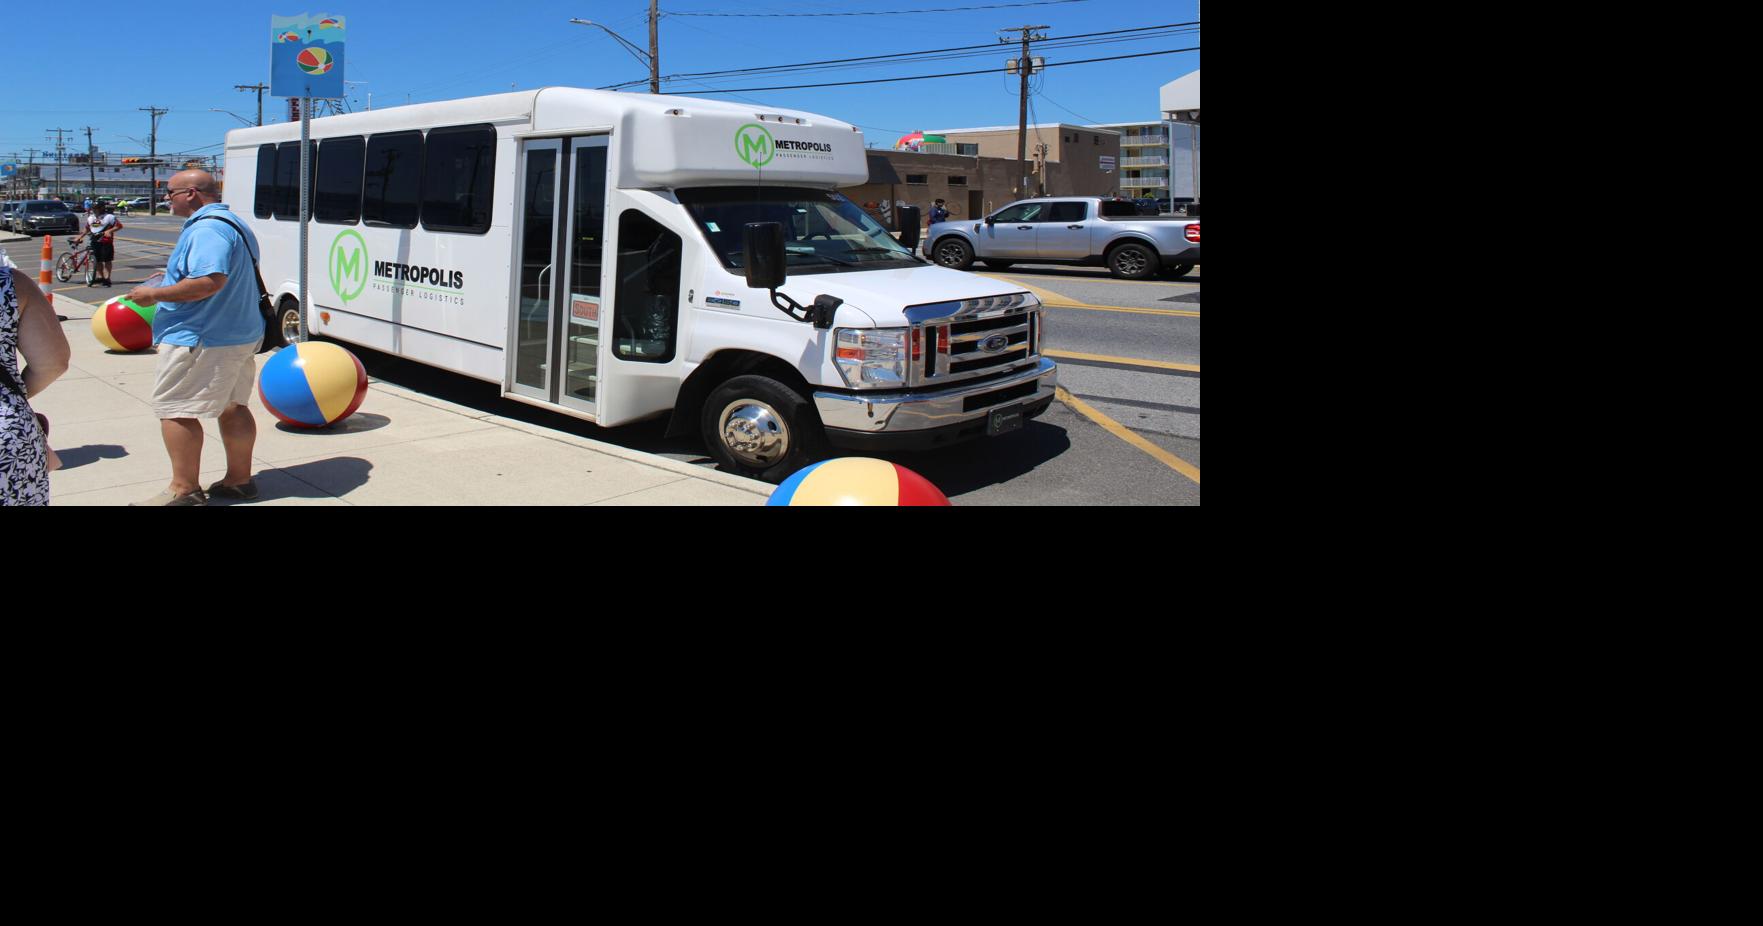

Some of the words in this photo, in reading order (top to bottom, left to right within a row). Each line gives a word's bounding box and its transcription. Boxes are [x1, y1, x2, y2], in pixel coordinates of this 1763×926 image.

[775, 140, 832, 153] METROPOLIS
[374, 260, 464, 290] METROPOLIS
[373, 283, 414, 296] PASSENGER
[418, 292, 464, 305] LOGISTICS
